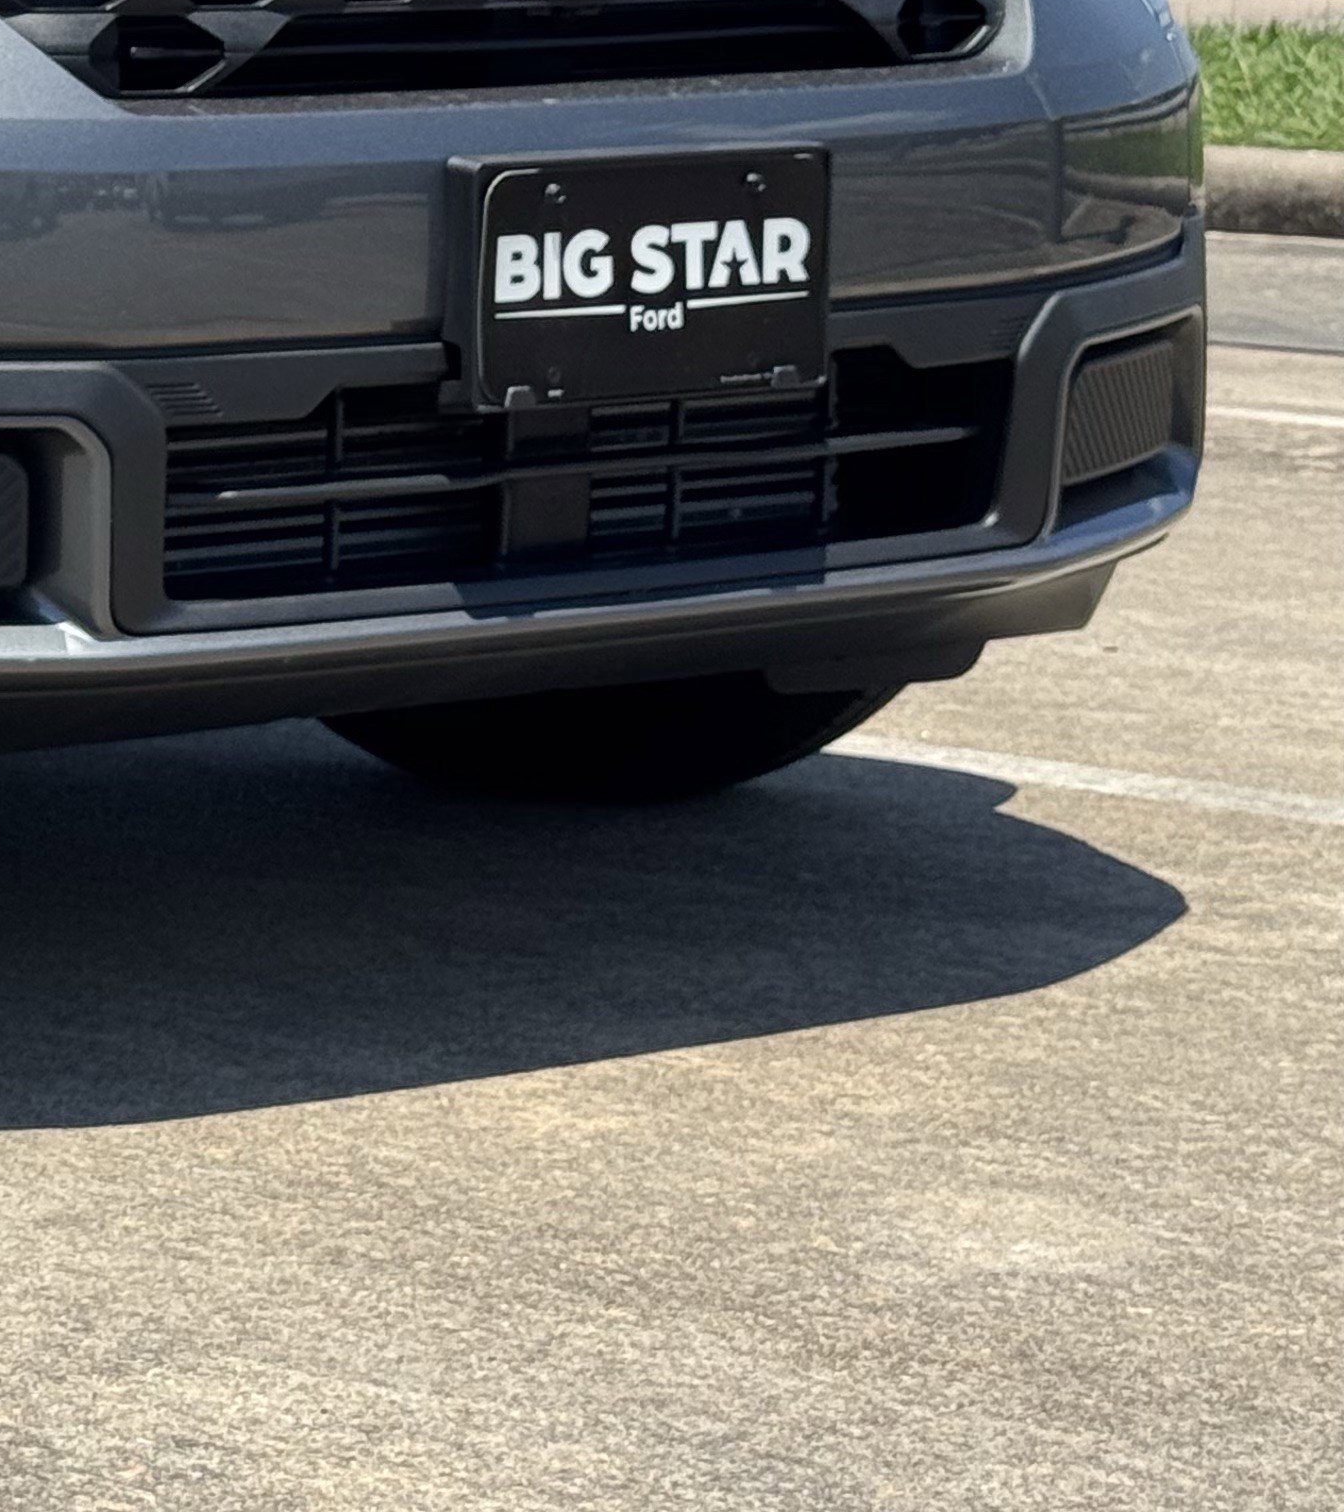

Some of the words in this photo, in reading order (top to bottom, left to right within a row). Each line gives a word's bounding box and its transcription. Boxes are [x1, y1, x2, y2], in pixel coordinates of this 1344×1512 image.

[493, 228, 615, 304] BIG
[629, 217, 811, 294] STAR
[629, 301, 685, 332] Ford
